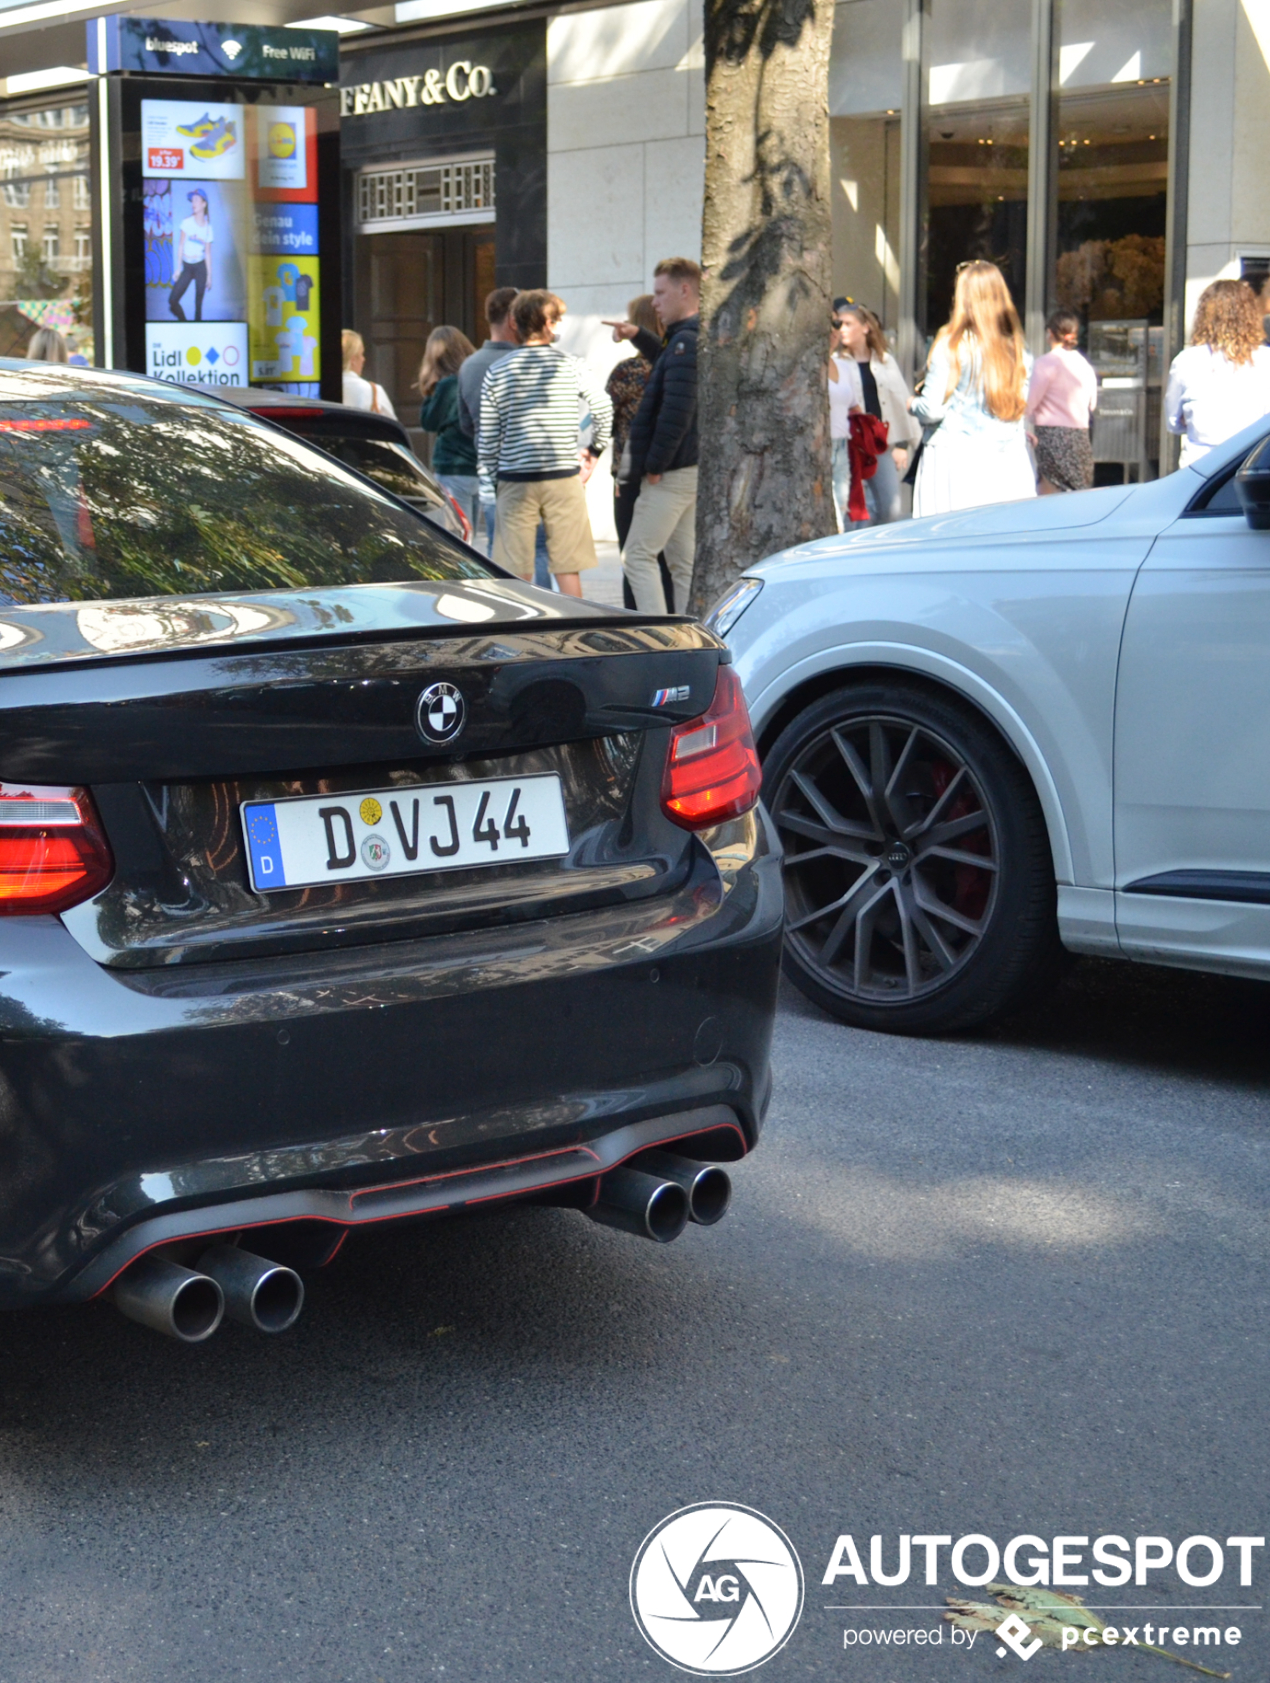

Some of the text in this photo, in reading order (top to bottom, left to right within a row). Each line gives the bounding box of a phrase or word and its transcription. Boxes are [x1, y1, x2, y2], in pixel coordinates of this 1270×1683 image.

[145, 37, 198, 56] bluespot
[262, 45, 315, 61] Free WiFi
[253, 213, 293, 228] Genau
[282, 231, 313, 249] style
[152, 350, 182, 367] Lidl
[424, 684, 462, 706] BMW
[319, 806, 357, 870] D
[260, 856, 274, 874] D
